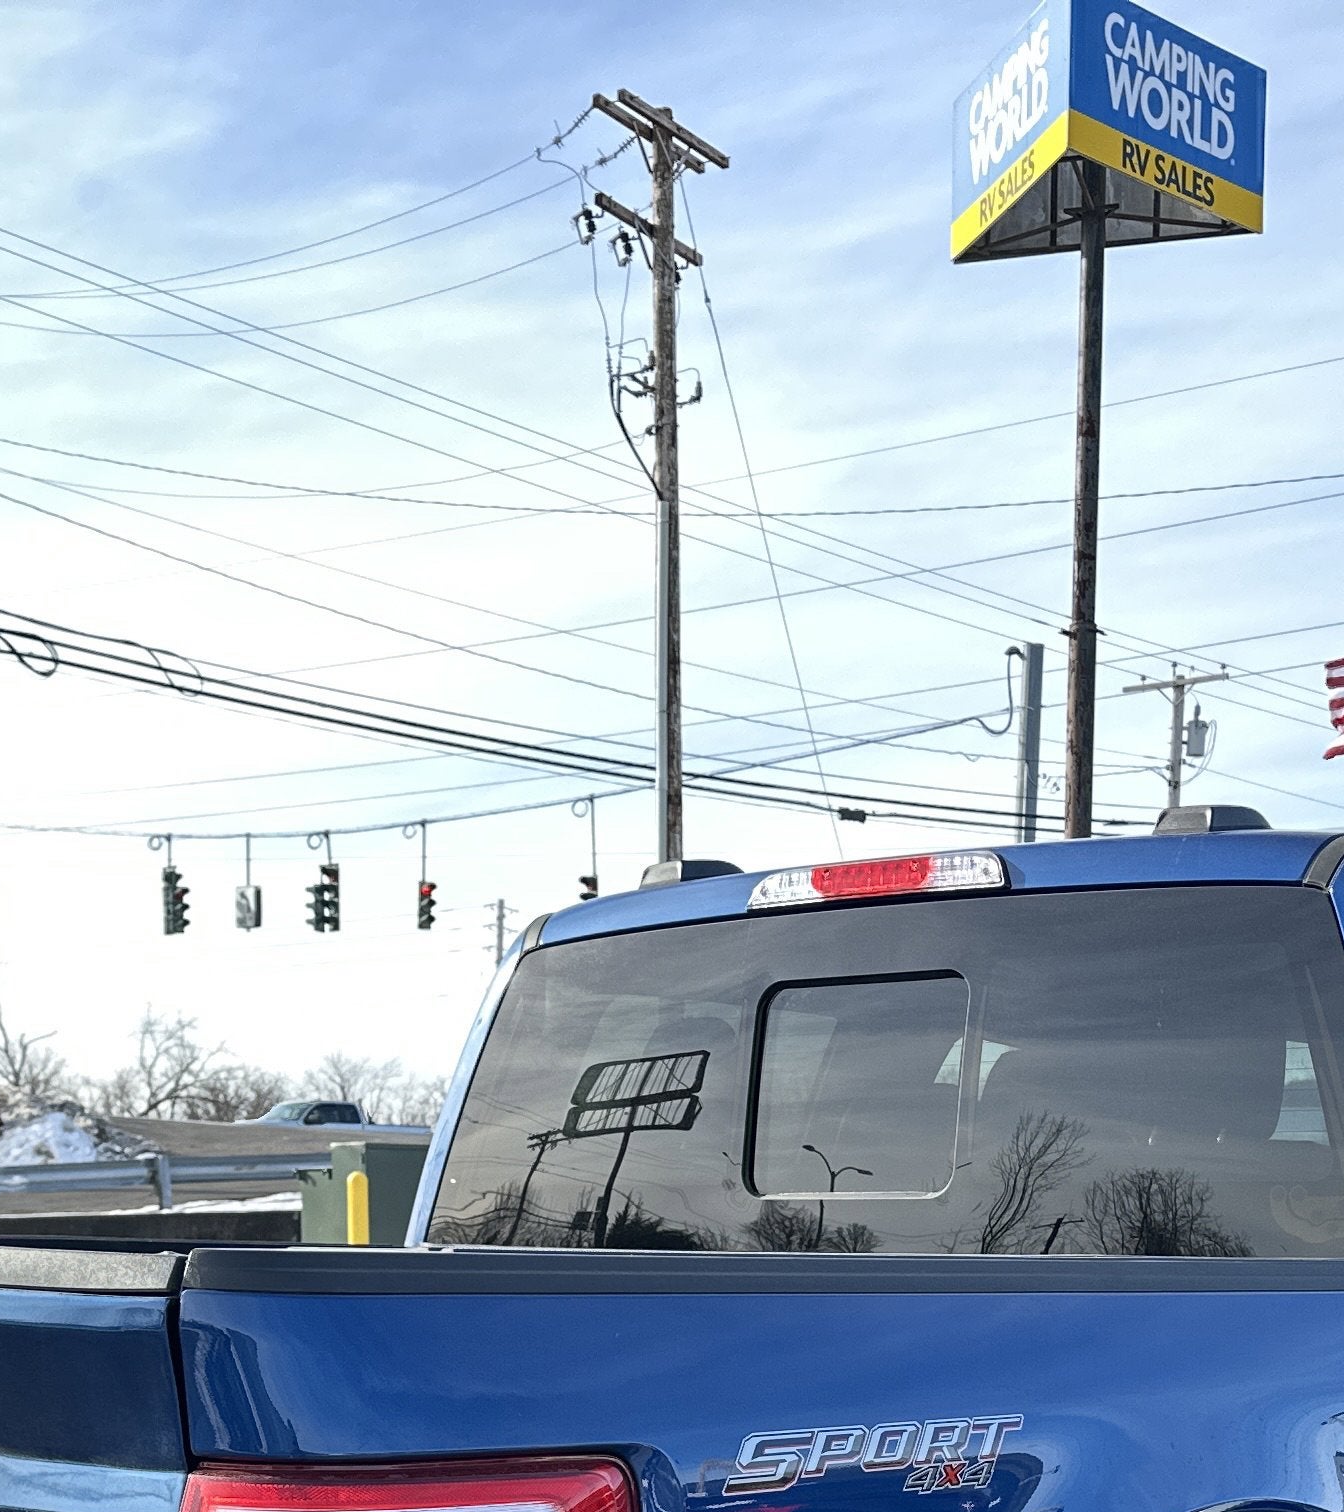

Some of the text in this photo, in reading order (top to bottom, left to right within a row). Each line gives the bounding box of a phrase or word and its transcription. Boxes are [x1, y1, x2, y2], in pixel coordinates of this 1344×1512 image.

[969, 18, 1049, 134] CAMPING
[1104, 12, 1235, 112] CAMPING
[979, 149, 1035, 227] RV SALES
[1122, 138, 1215, 207] RV SALES
[722, 1413, 1025, 1497] SPORT
